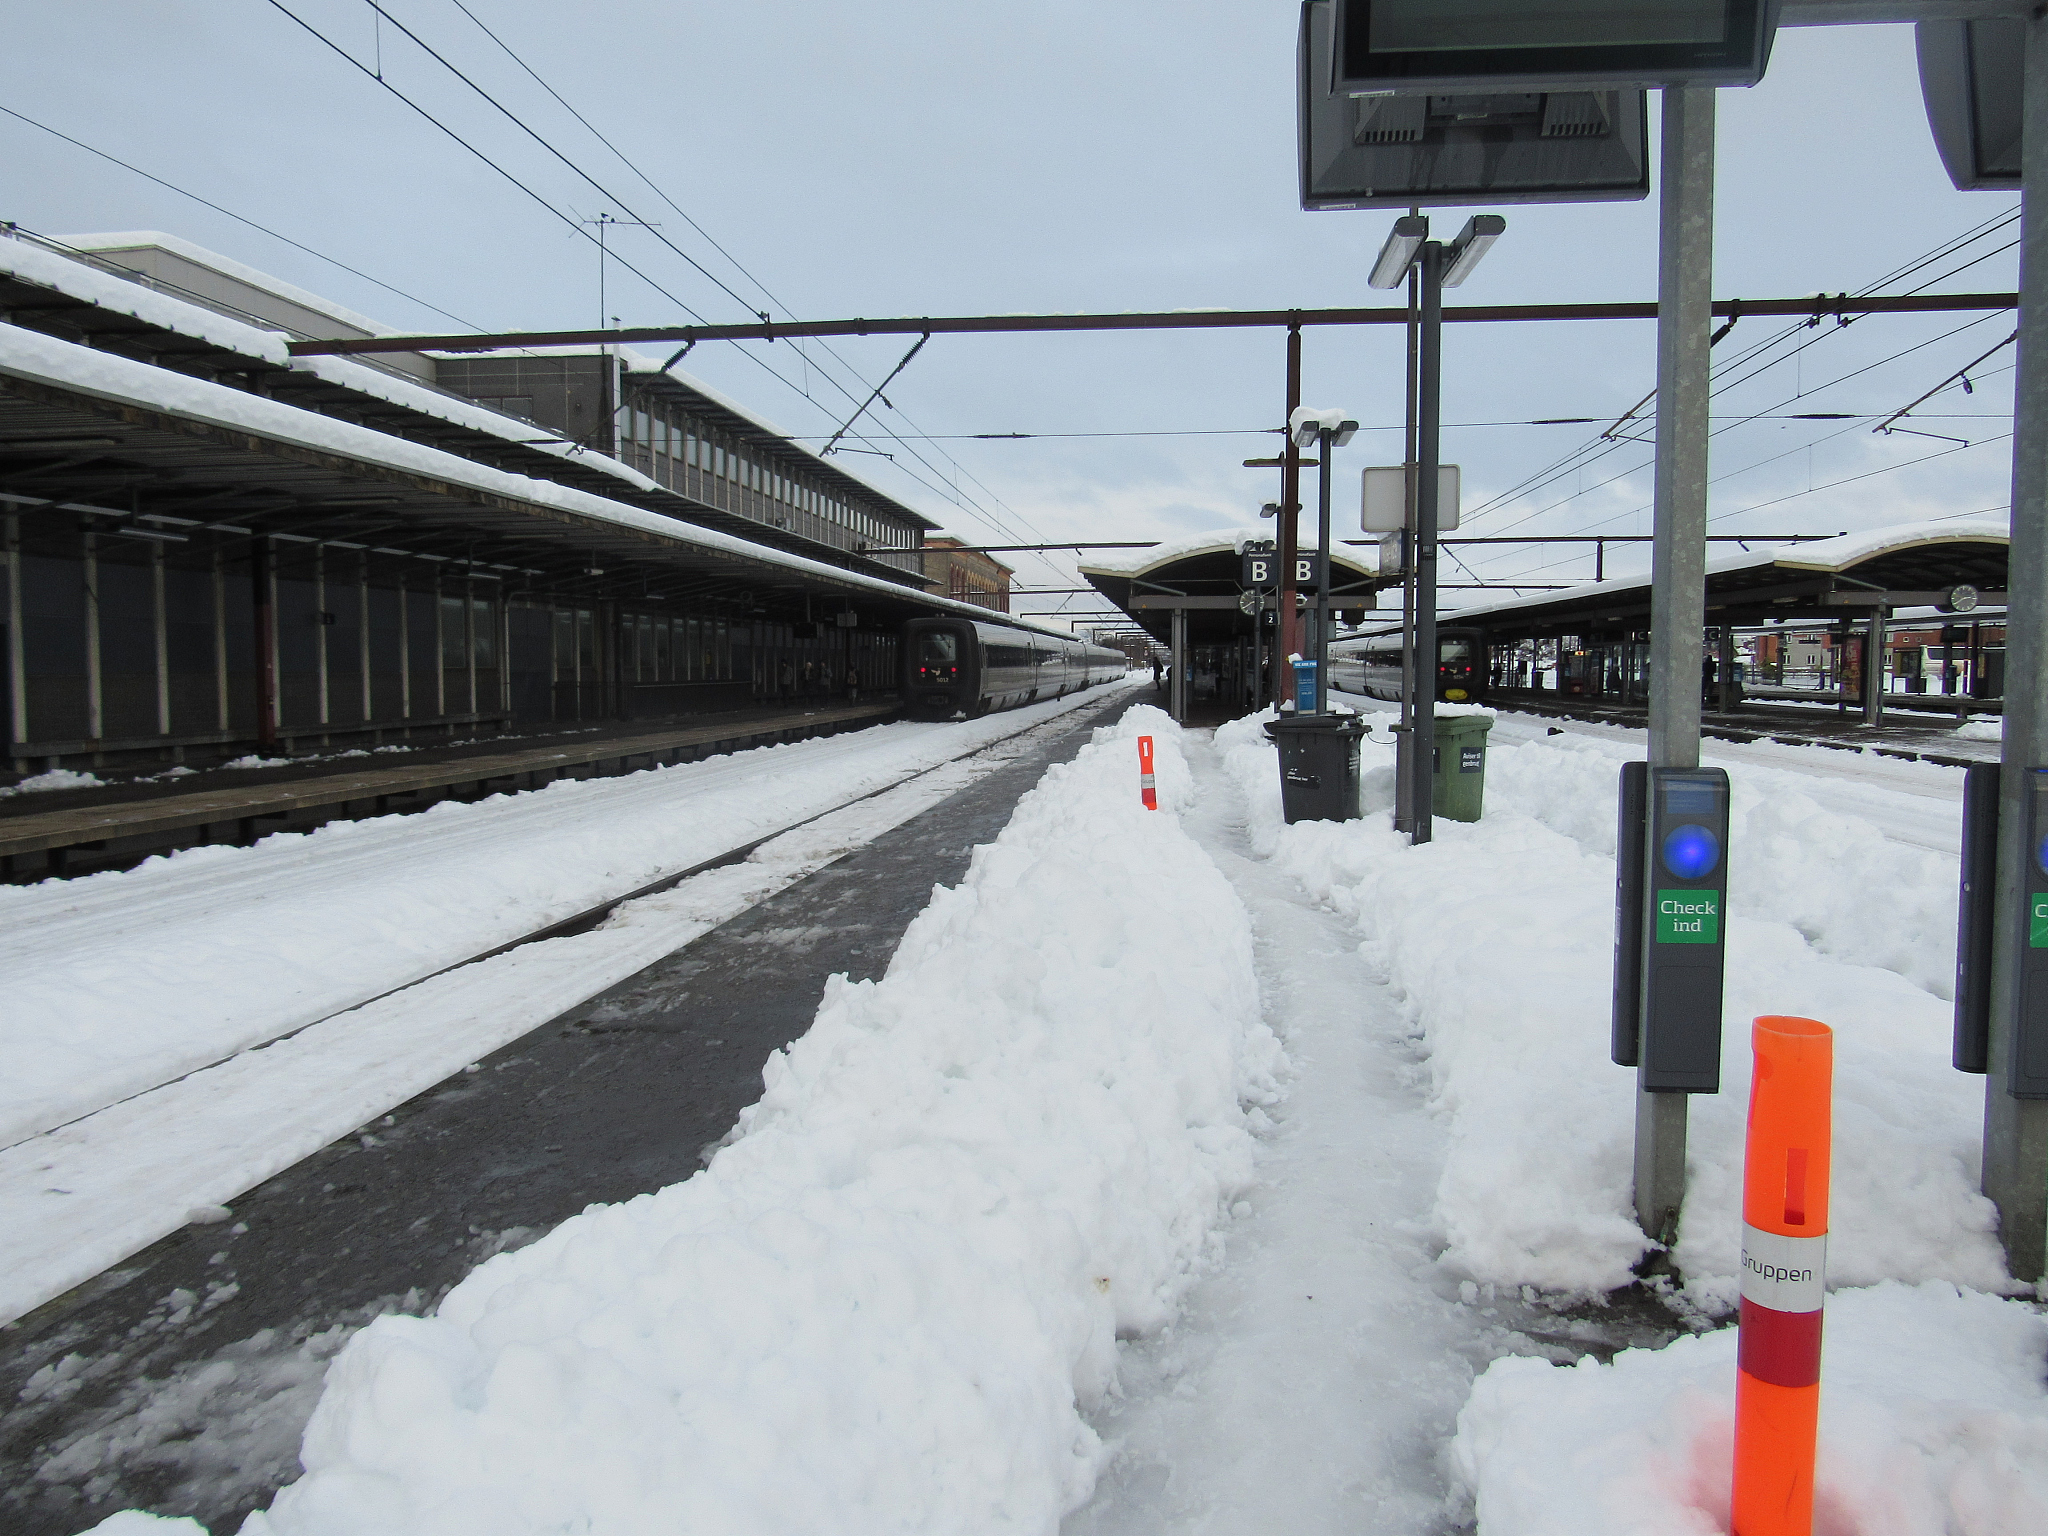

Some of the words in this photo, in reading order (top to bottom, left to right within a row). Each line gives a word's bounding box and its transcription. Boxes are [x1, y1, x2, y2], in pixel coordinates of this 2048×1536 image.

[1252, 561, 1268, 582] B
[1295, 560, 1312, 581] B
[1268, 616, 1274, 624] 2
[1637, 631, 1645, 640] C
[1708, 630, 1716, 640] C
[1660, 900, 1716, 915] Check
[1673, 918, 1701, 932] ind
[1741, 1248, 1812, 1283] Gruppen
